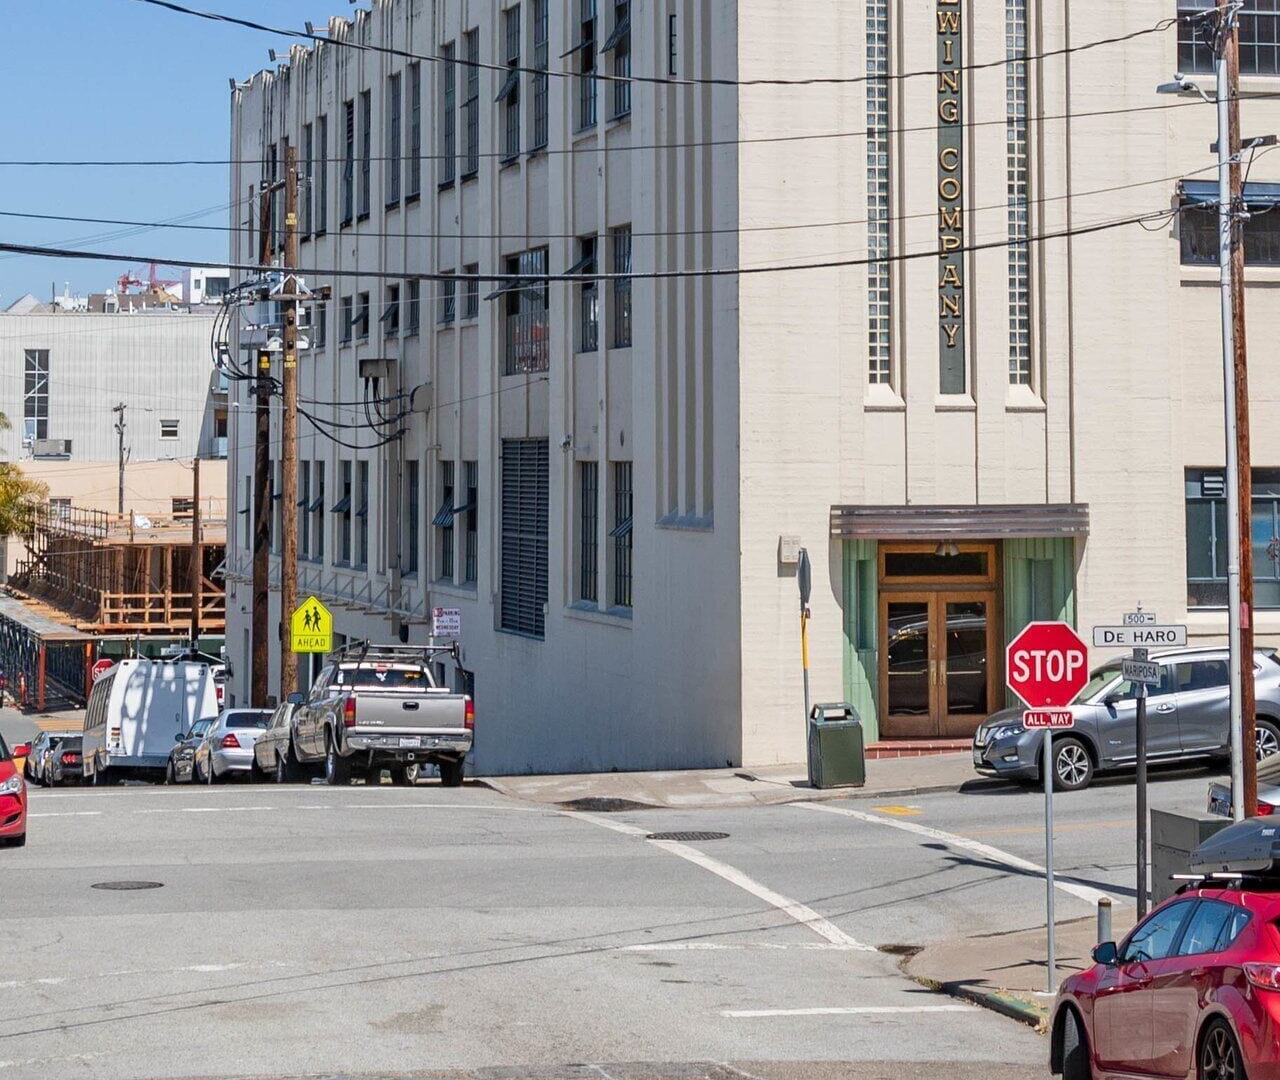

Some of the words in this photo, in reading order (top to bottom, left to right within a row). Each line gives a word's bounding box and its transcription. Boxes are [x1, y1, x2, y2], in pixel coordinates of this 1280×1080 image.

[938, 148, 963, 348] COMPANY
[1127, 614, 1145, 624] 500
[1133, 630, 1177, 642] HARO
[297, 638, 326, 648] AHEAD
[1012, 649, 1084, 682] STOP
[1124, 663, 1158, 679] MARIPOSA
[1027, 713, 1048, 726] ALL
[1048, 713, 1071, 725] WAY
